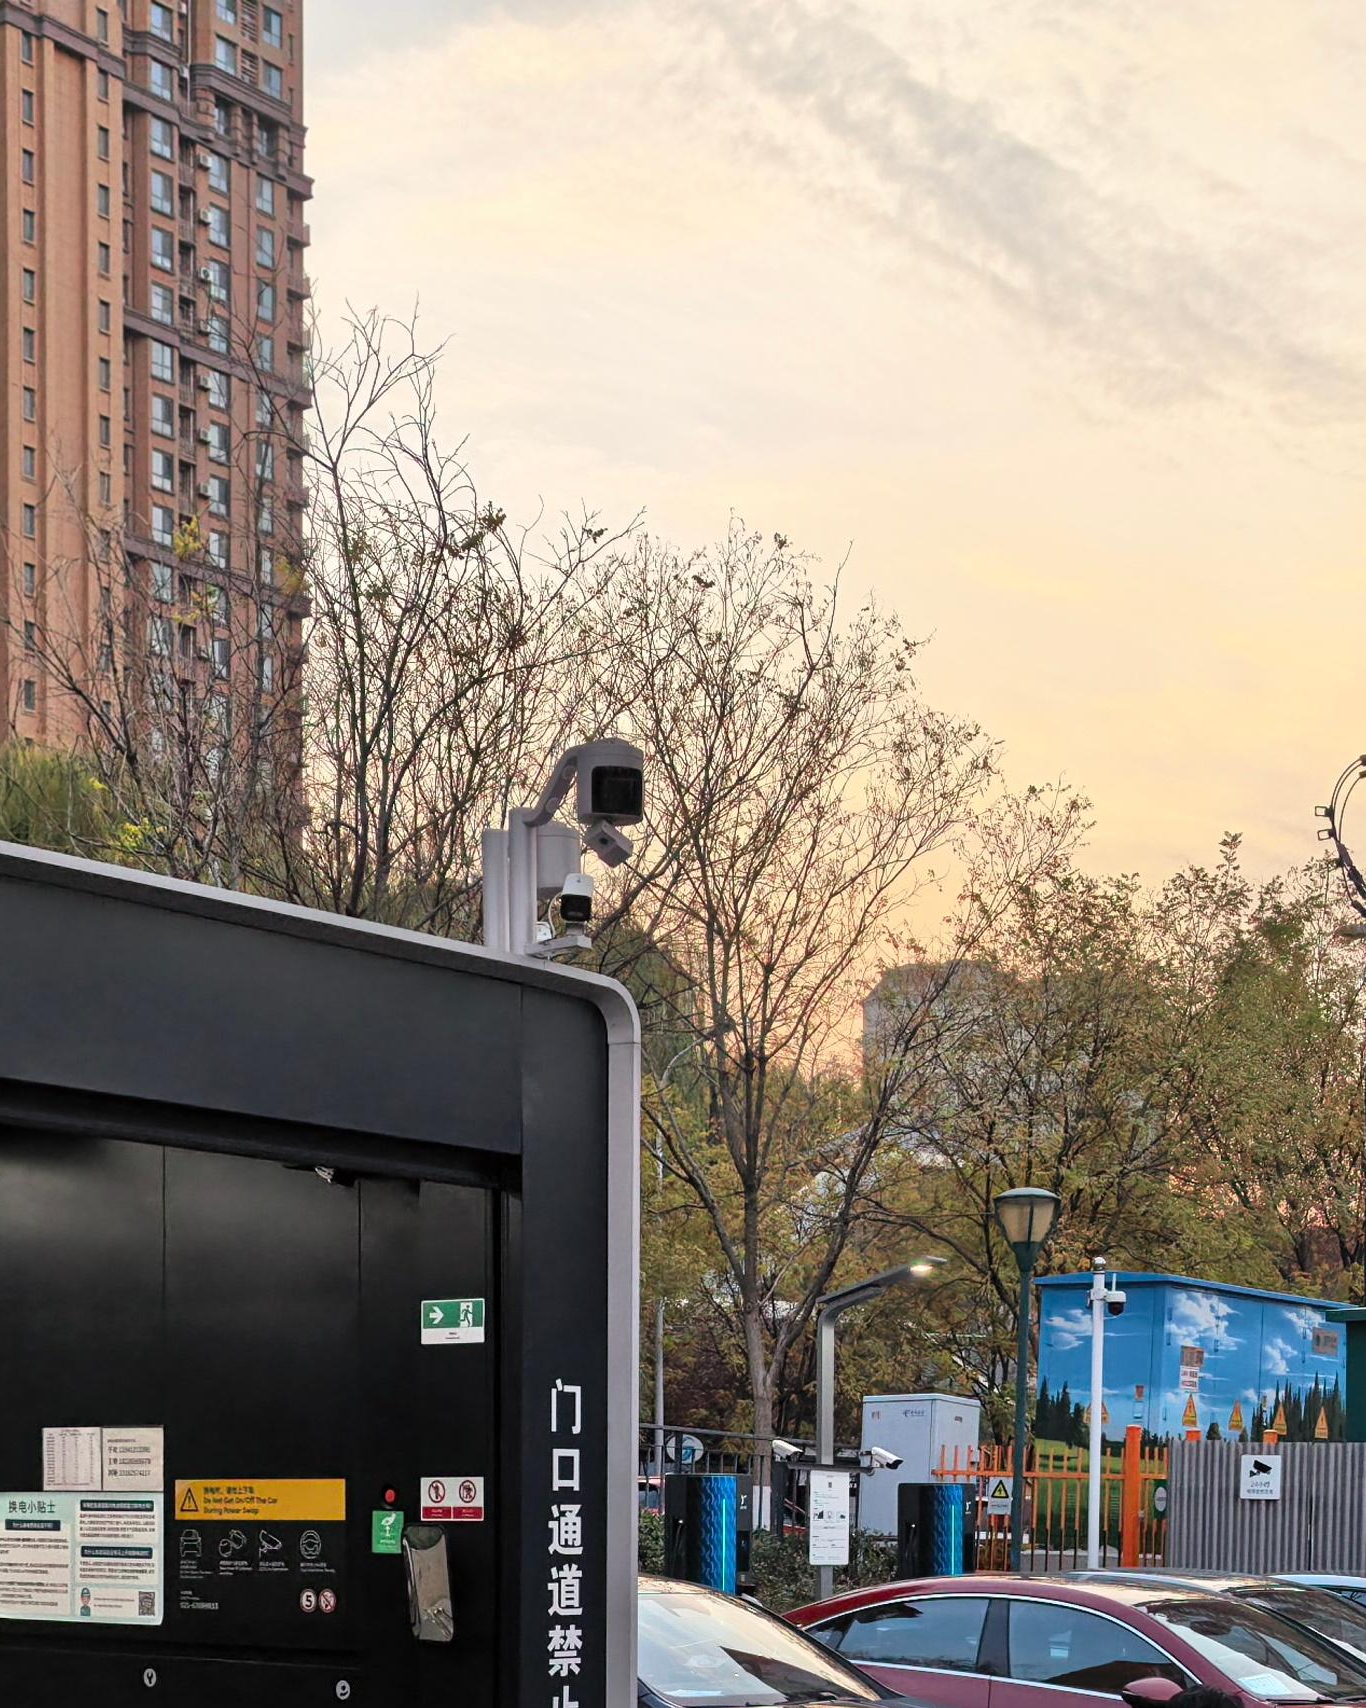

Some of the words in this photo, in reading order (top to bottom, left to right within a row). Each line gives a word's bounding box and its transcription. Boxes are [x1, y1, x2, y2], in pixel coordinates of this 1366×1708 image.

[8, 1501, 56, 1514] 换电小贴士
